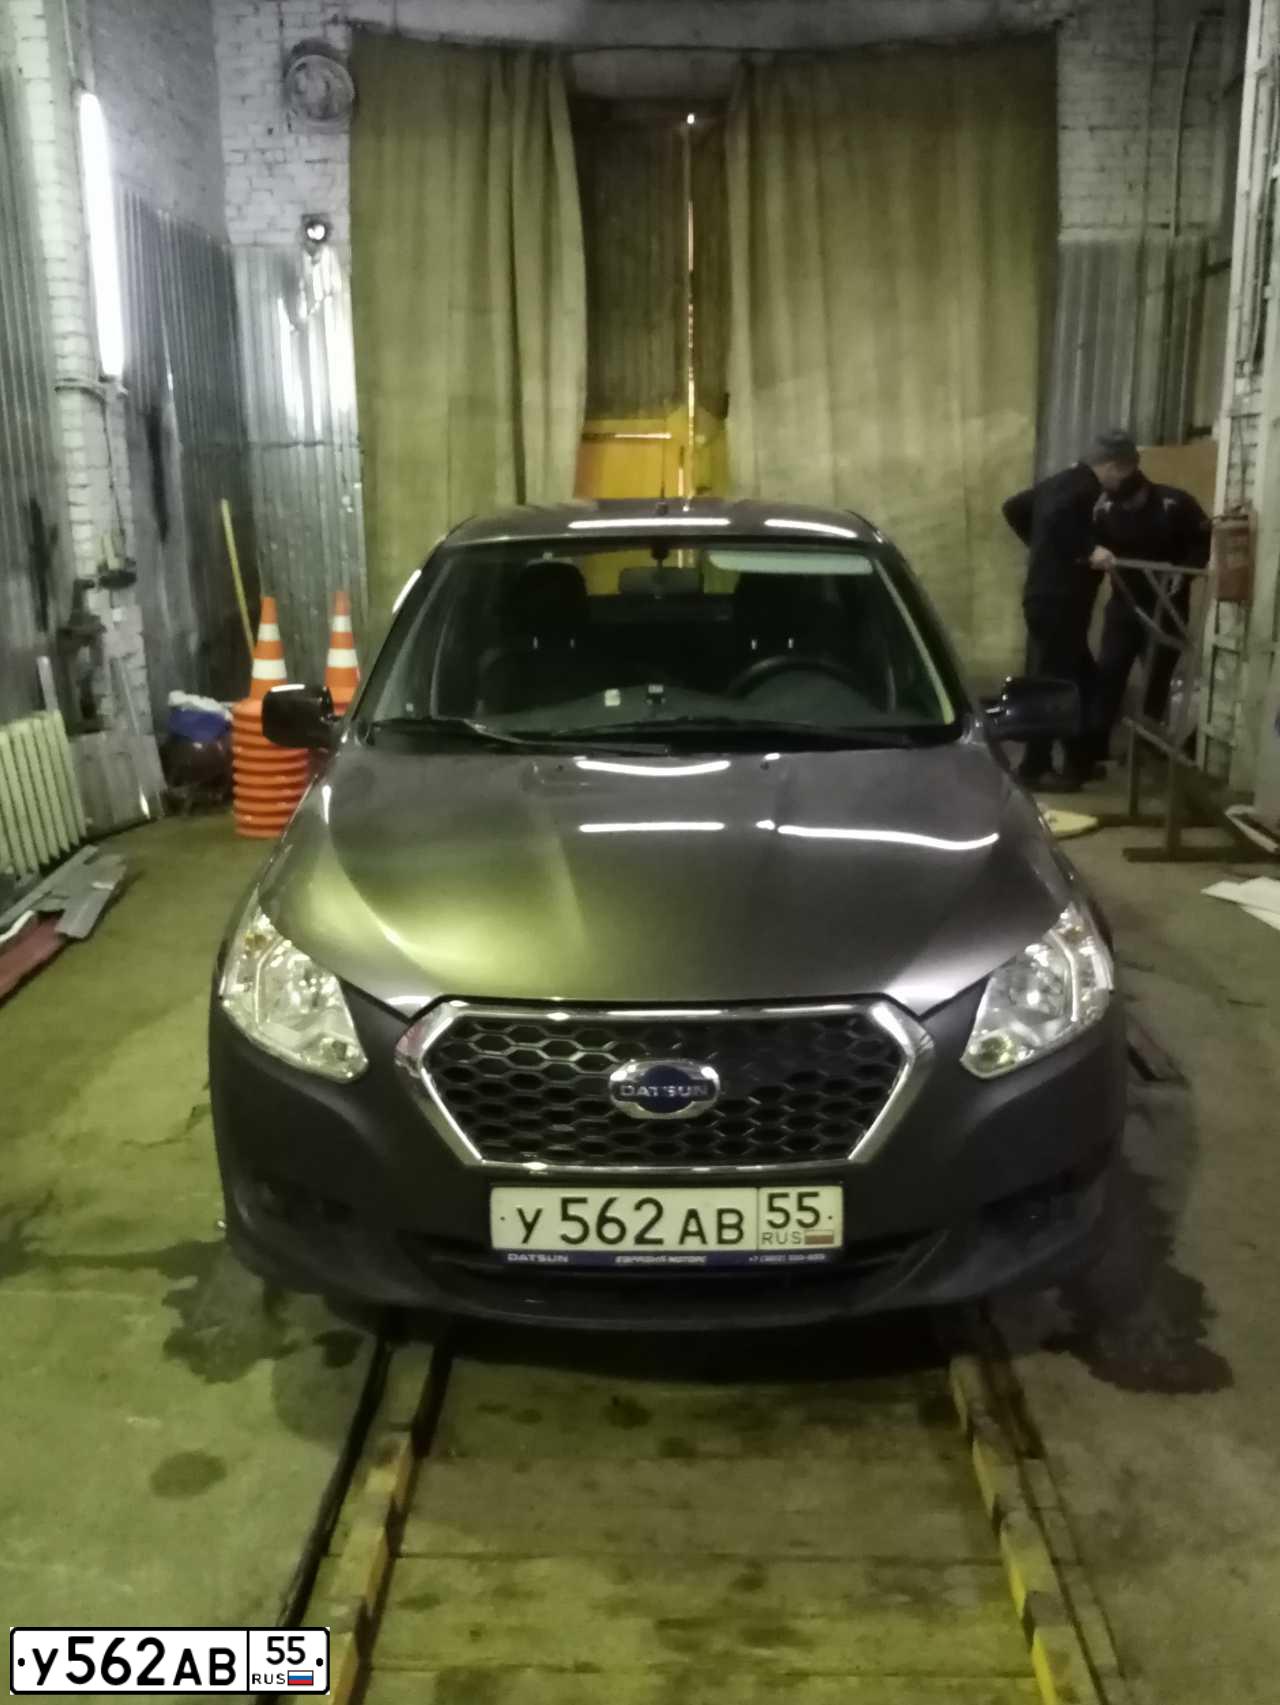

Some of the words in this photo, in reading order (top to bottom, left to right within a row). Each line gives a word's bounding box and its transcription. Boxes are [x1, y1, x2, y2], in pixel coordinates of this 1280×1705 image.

[620, 1085, 707, 1097] DATSUN
[767, 1191, 821, 1229] 55
[761, 1231, 803, 1245] RUS
[507, 1252, 569, 1263] DATSUN
